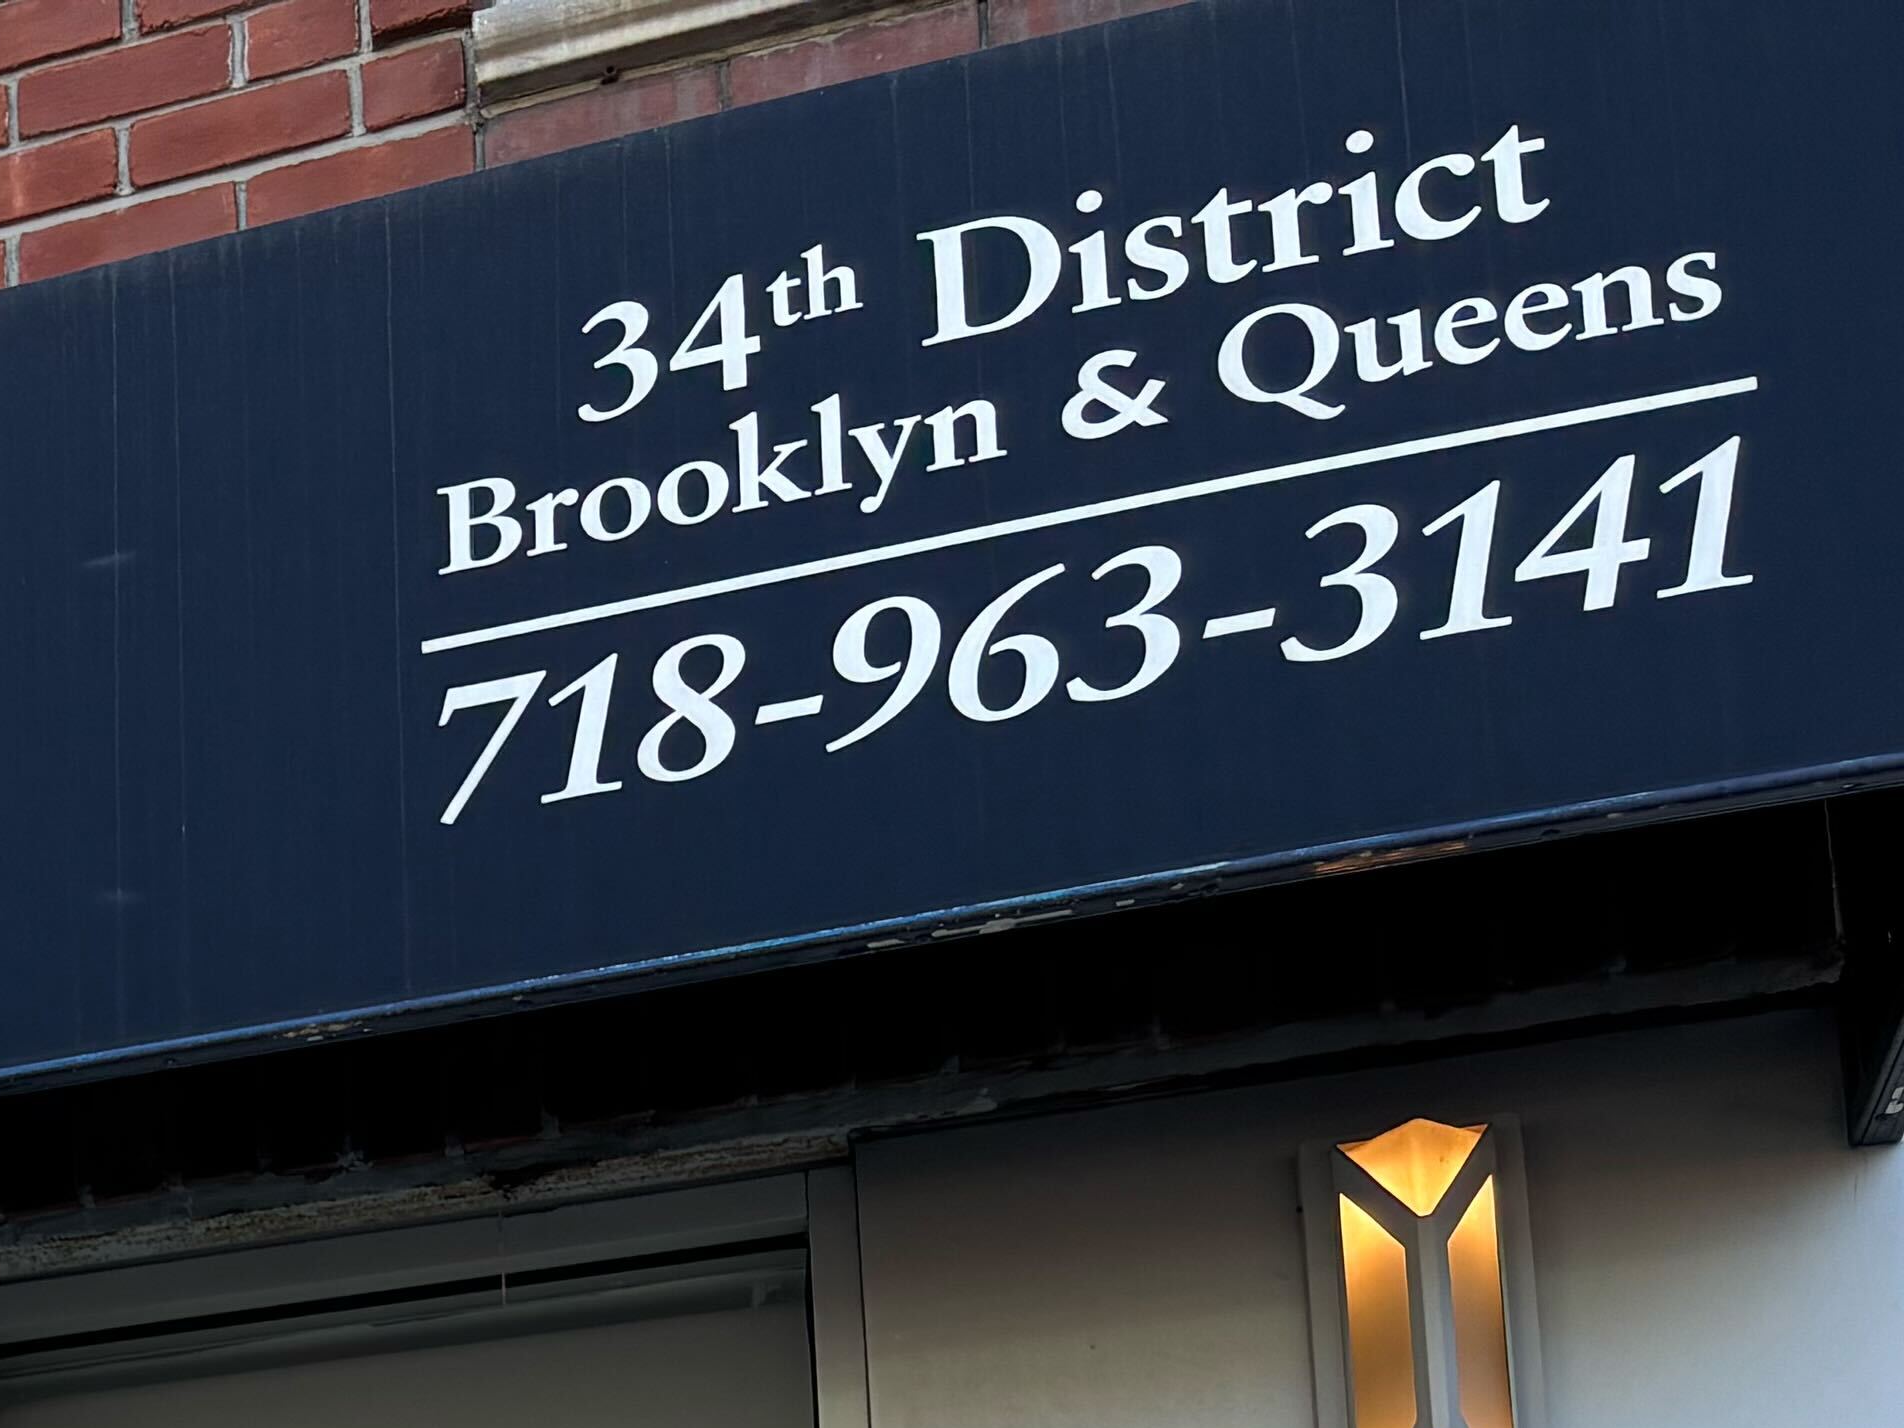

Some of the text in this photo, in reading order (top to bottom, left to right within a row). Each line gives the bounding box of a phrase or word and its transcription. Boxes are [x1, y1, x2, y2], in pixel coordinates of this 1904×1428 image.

[437, 252, 1721, 574] Brooklyn & Queens
[579, 125, 1549, 421] 34th District
[439, 436, 1753, 824] 718-963-3141
